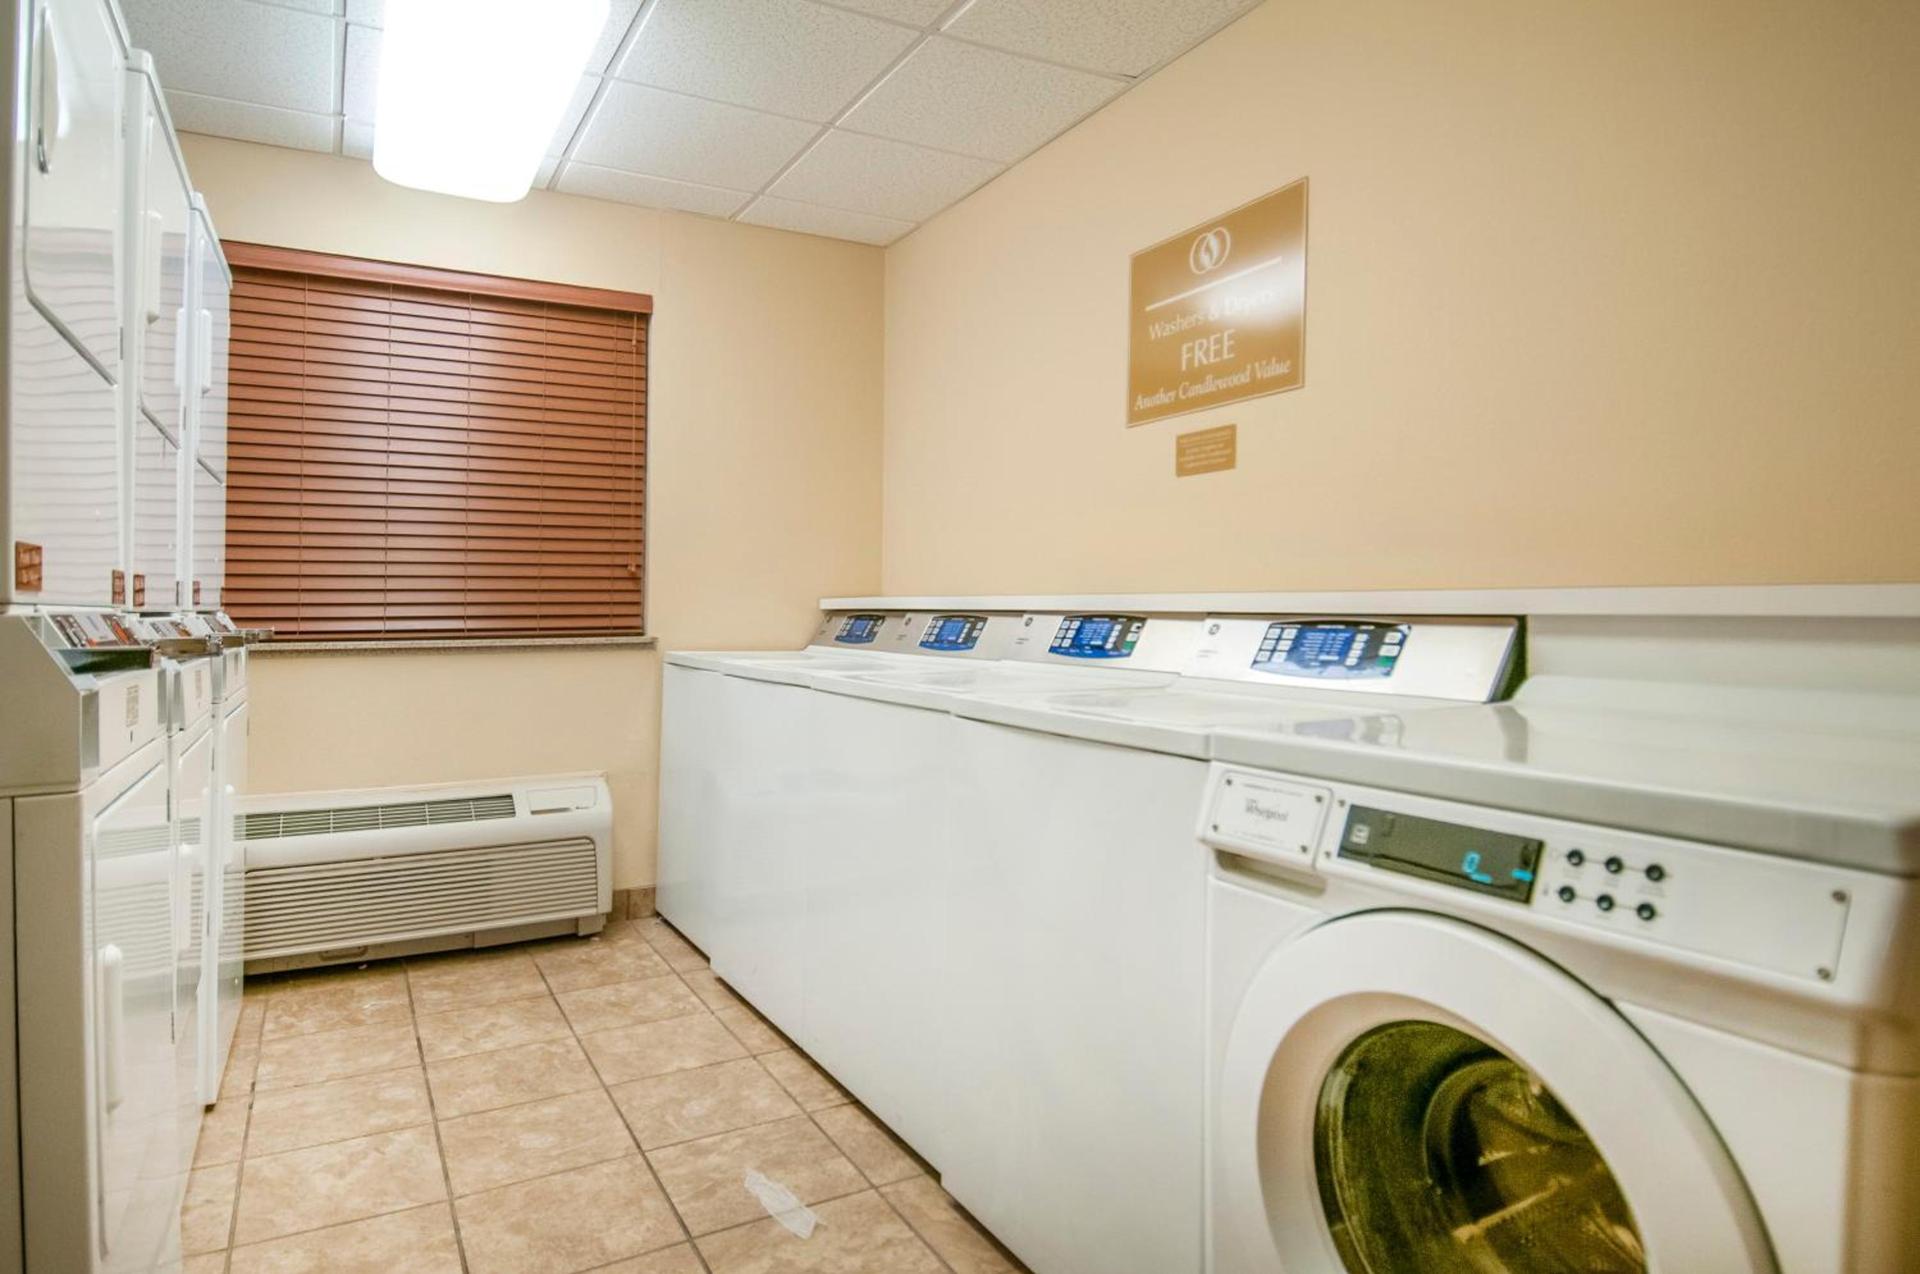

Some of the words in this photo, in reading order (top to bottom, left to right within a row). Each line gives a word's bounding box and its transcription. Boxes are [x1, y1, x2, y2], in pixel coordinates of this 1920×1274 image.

[1149, 313, 1205, 341] Washers
[1181, 328, 1237, 372] FREE
[1134, 387, 1178, 411] Another
[1178, 363, 1252, 399] Candlewood
[1254, 356, 1292, 380] Value
